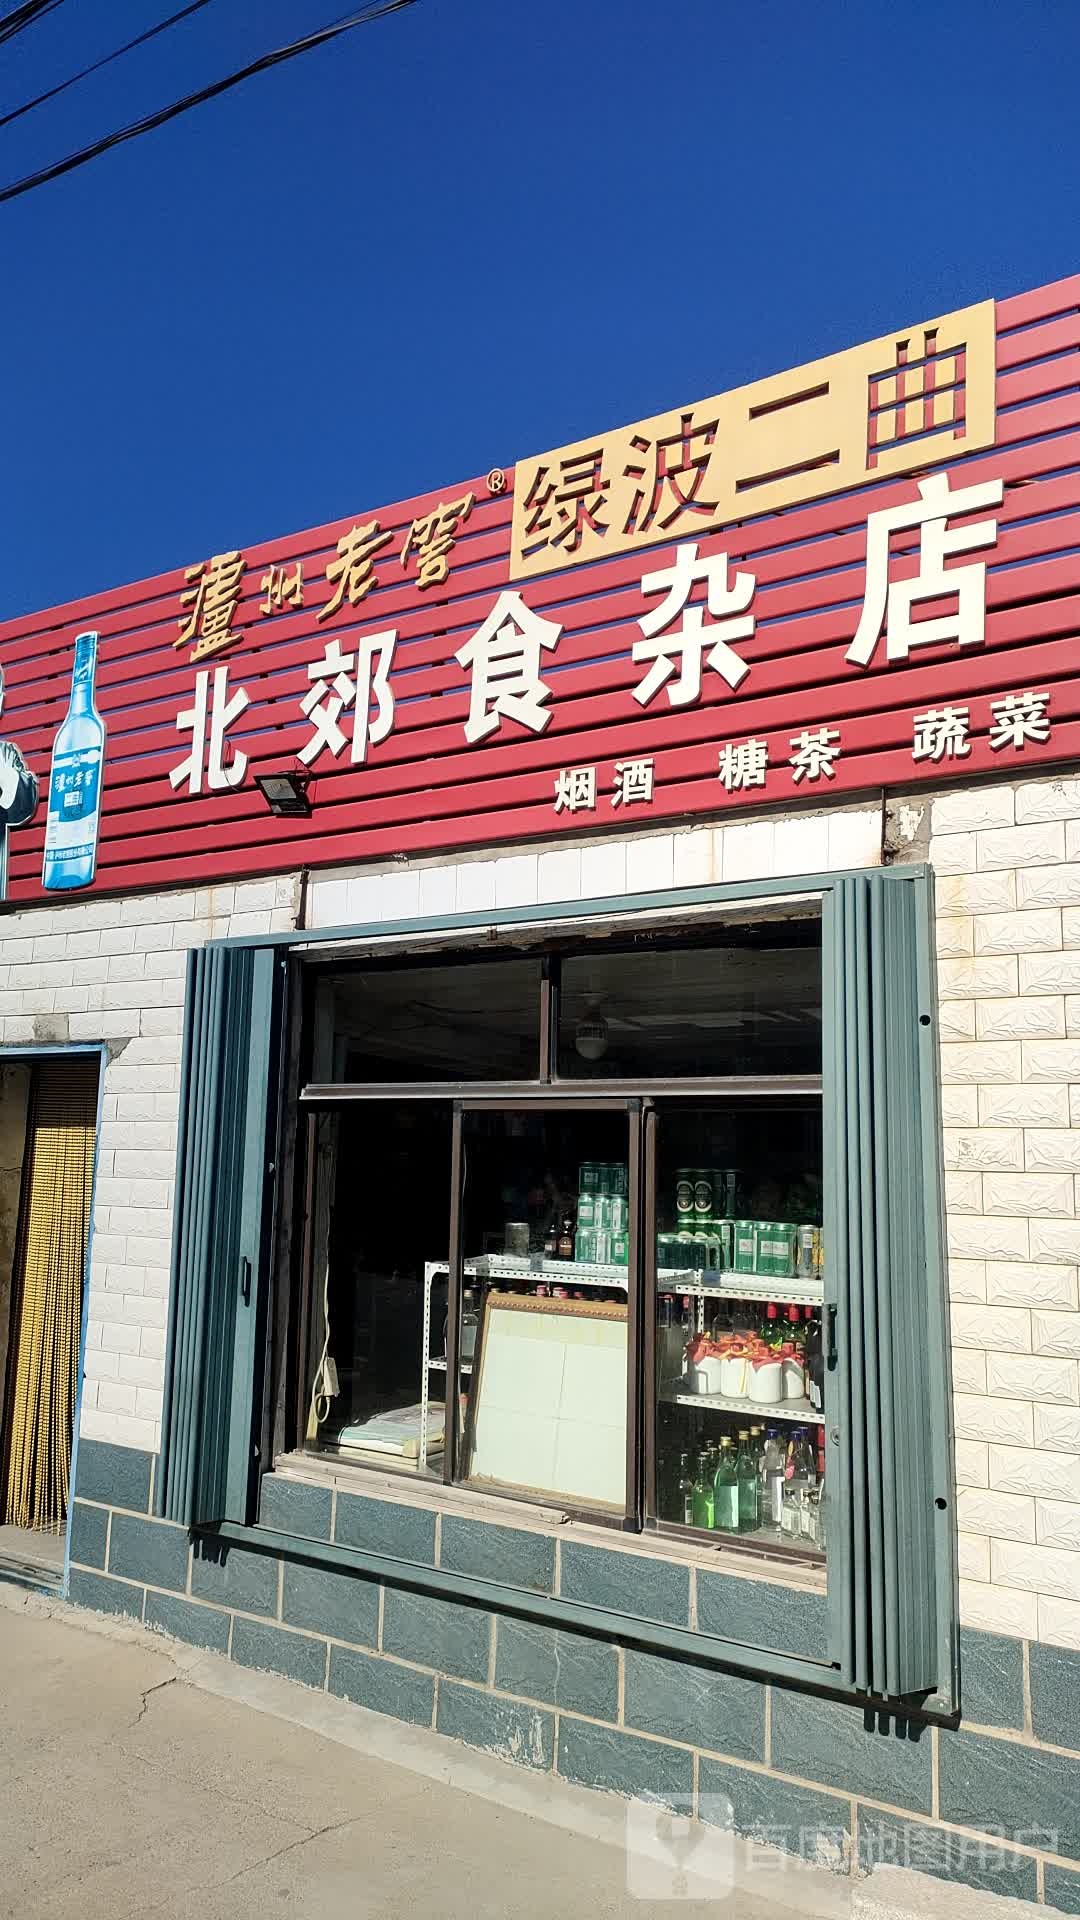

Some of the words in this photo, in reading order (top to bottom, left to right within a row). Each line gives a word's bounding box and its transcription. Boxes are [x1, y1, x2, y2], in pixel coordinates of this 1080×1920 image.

[520, 327, 967, 560] 绿波二曲
[168, 472, 1003, 793] 北郊食杂店
[554, 756, 655, 812] 烟酒
[718, 727, 842, 789] 糖茶
[911, 691, 1052, 760] 蔬菜
